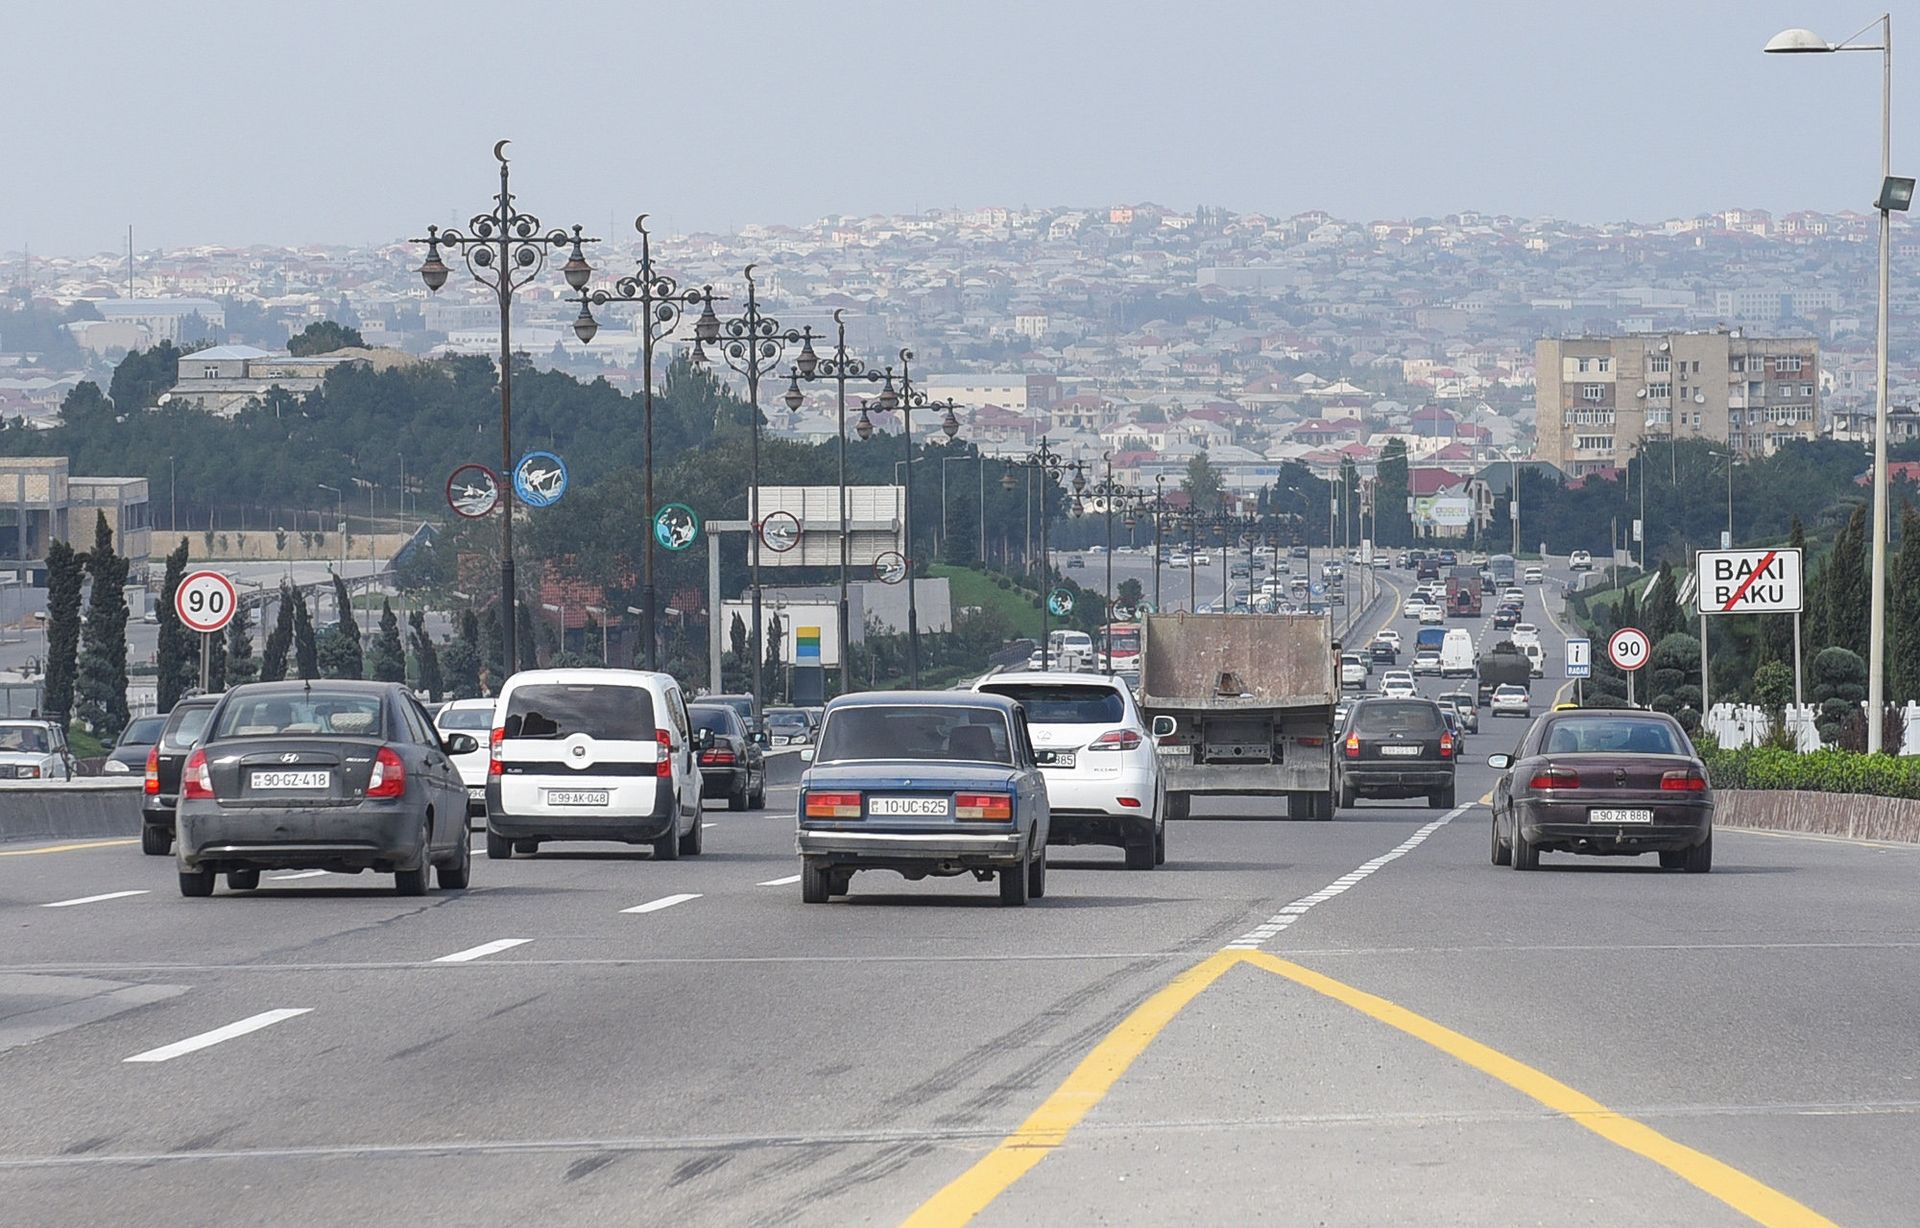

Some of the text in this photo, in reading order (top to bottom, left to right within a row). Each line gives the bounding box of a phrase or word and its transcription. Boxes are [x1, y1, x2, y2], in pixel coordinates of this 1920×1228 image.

[1715, 558, 1783, 580] BAKI
[189, 590, 224, 613] 90
[1715, 585, 1783, 604] BAKU
[1618, 641, 1640, 656] 90
[263, 773, 326, 786] 90-GZ-418
[558, 793, 606, 803] 99-AK-048
[885, 800, 946, 813] 10-UC-625
